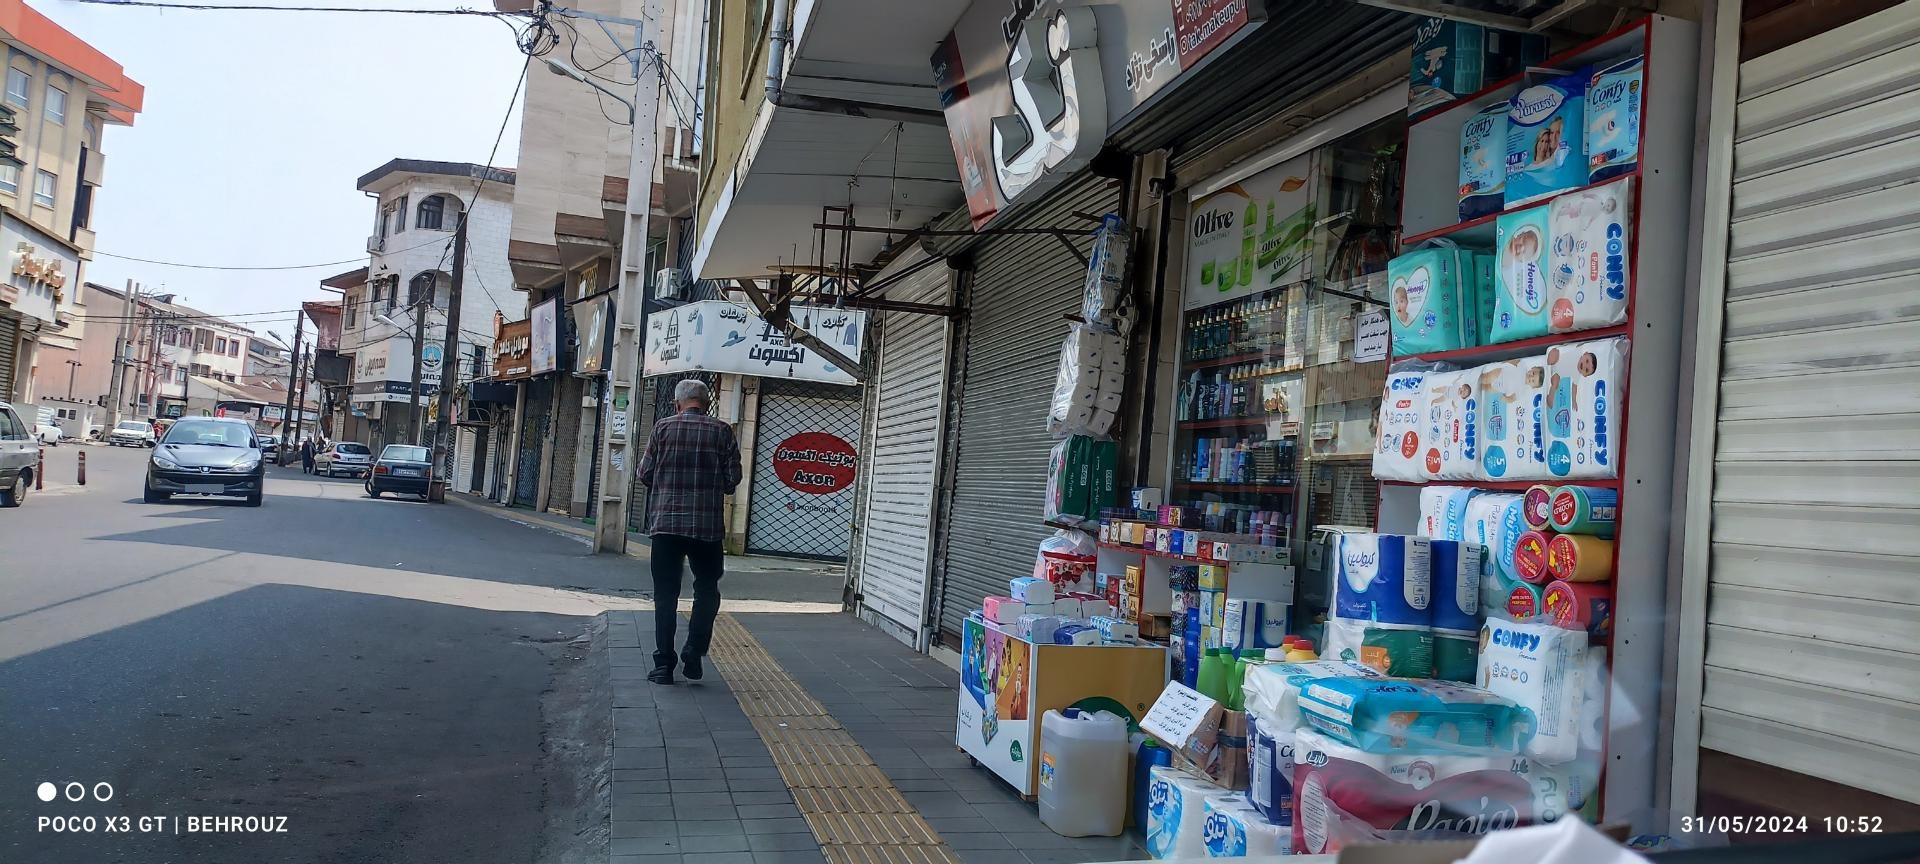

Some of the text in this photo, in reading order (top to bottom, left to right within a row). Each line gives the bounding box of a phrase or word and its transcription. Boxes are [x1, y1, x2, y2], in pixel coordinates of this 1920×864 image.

[1592, 80, 1627, 105] Confy
[1465, 116, 1495, 138] Confy
[1193, 208, 1235, 238] Olive
[1261, 237, 1281, 253] Olive
[1273, 253, 1291, 270] Olive
[1606, 222, 1625, 300] CONFY
[748, 344, 805, 367] اکسون
[1464, 398, 1476, 460] CONFY
[1594, 379, 1607, 466] CONFY
[1407, 433, 1412, 444] 6
[777, 446, 856, 468] بوتیک اکسون
[1496, 457, 1505, 466] 5
[1560, 454, 1570, 464] 4
[792, 470, 836, 486] Axon
[1503, 505, 1518, 567] My Baby
[1492, 628, 1541, 652] CONFY
[1390, 764, 1407, 775] New
